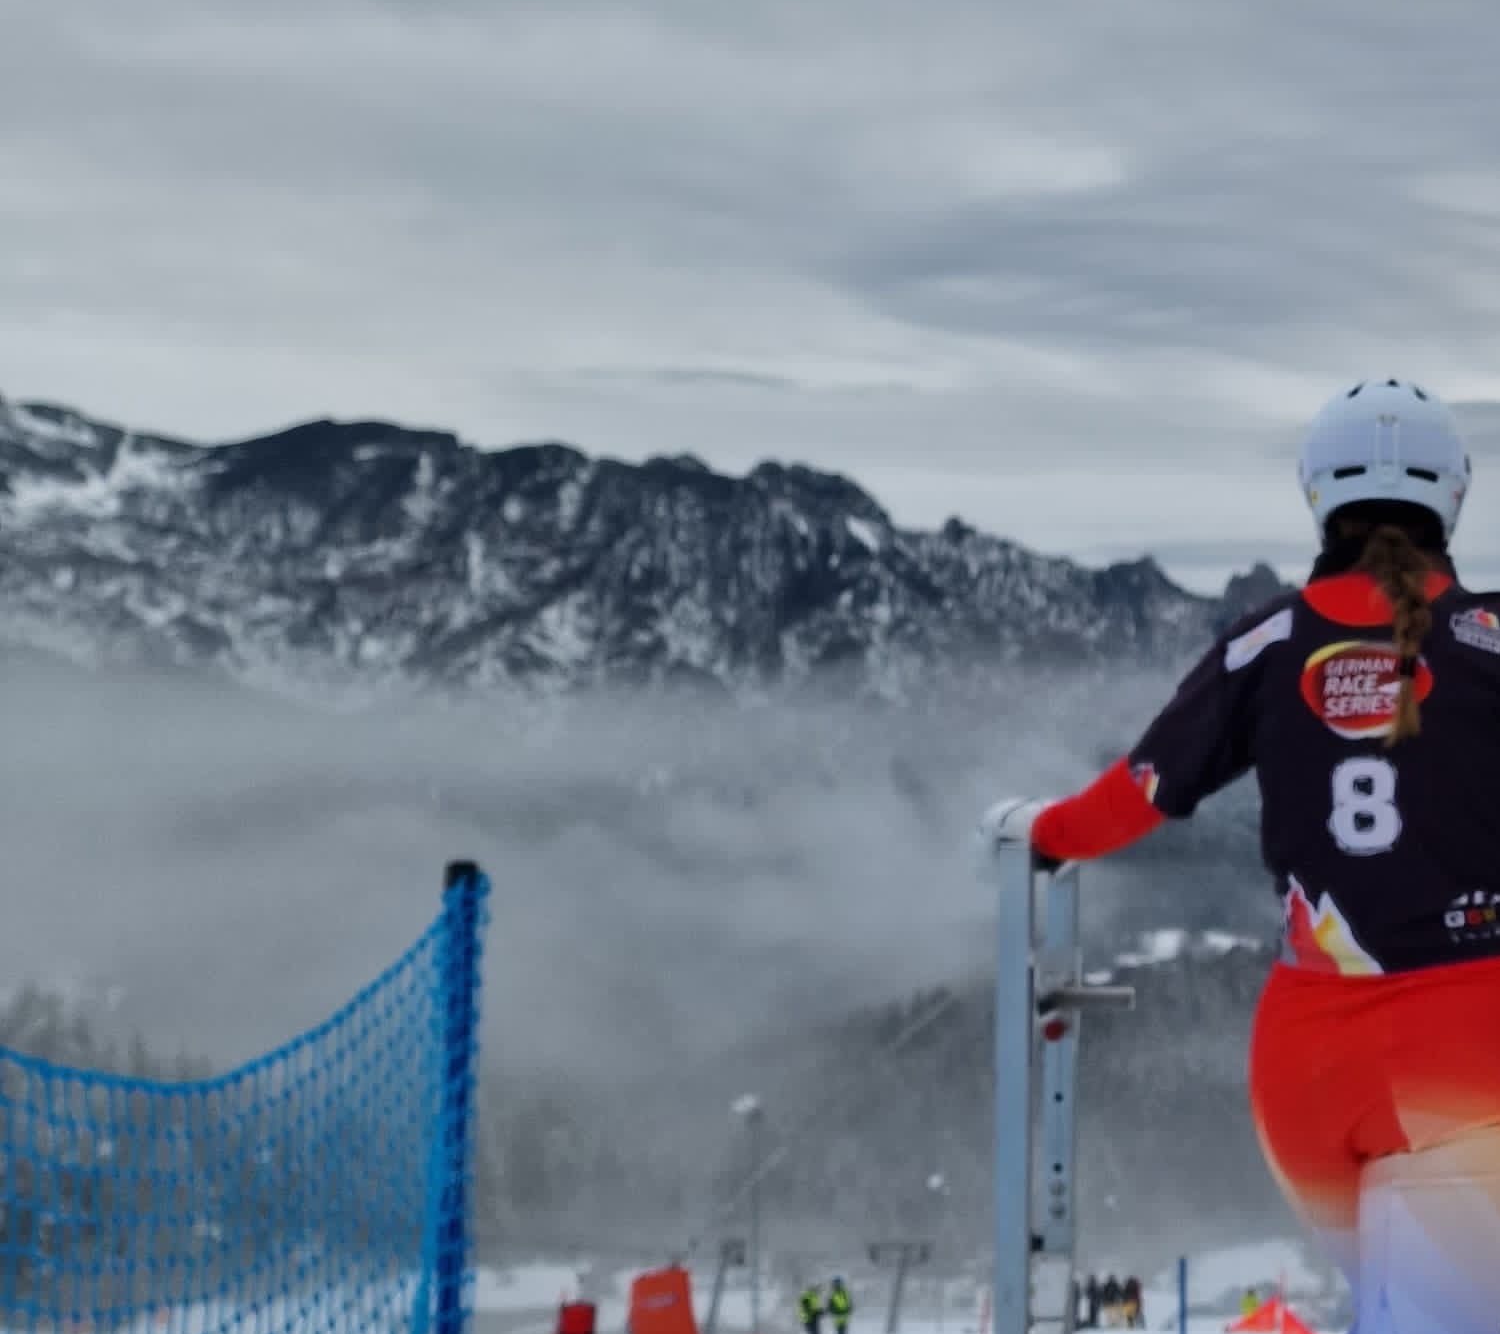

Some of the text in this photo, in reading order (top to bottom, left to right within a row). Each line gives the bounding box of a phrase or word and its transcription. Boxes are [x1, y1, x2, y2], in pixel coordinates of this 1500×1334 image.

[1325, 658, 1396, 675] GERMAN
[1323, 674, 1378, 695] RACE
[1324, 695, 1397, 717] SERIES
[1328, 757, 1402, 855] 8
